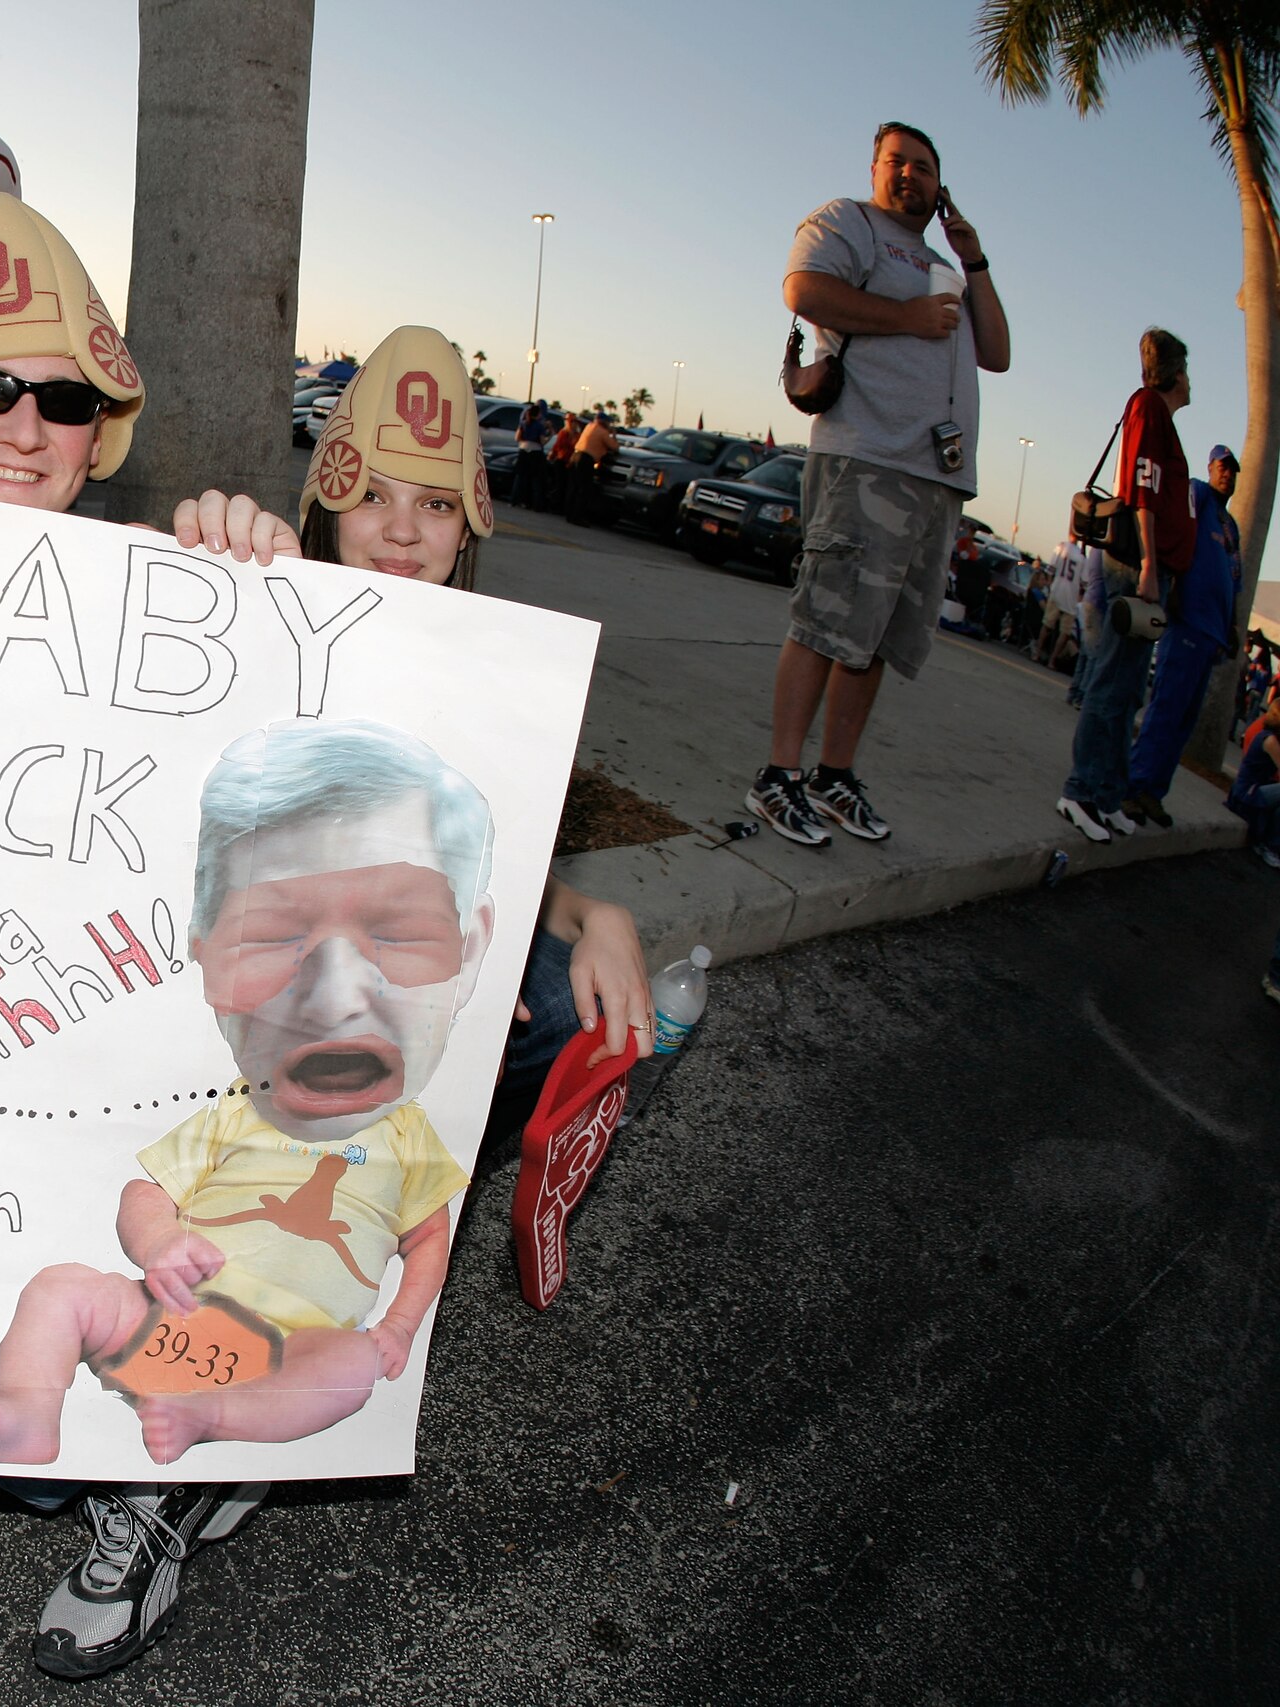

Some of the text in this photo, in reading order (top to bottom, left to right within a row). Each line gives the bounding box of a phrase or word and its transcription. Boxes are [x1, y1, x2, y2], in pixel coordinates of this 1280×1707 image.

[396, 371, 451, 449] OU
[1137, 456, 1161, 494] 20
[1060, 557, 1077, 580] 15
[144, 1323, 239, 1385] 39-33
